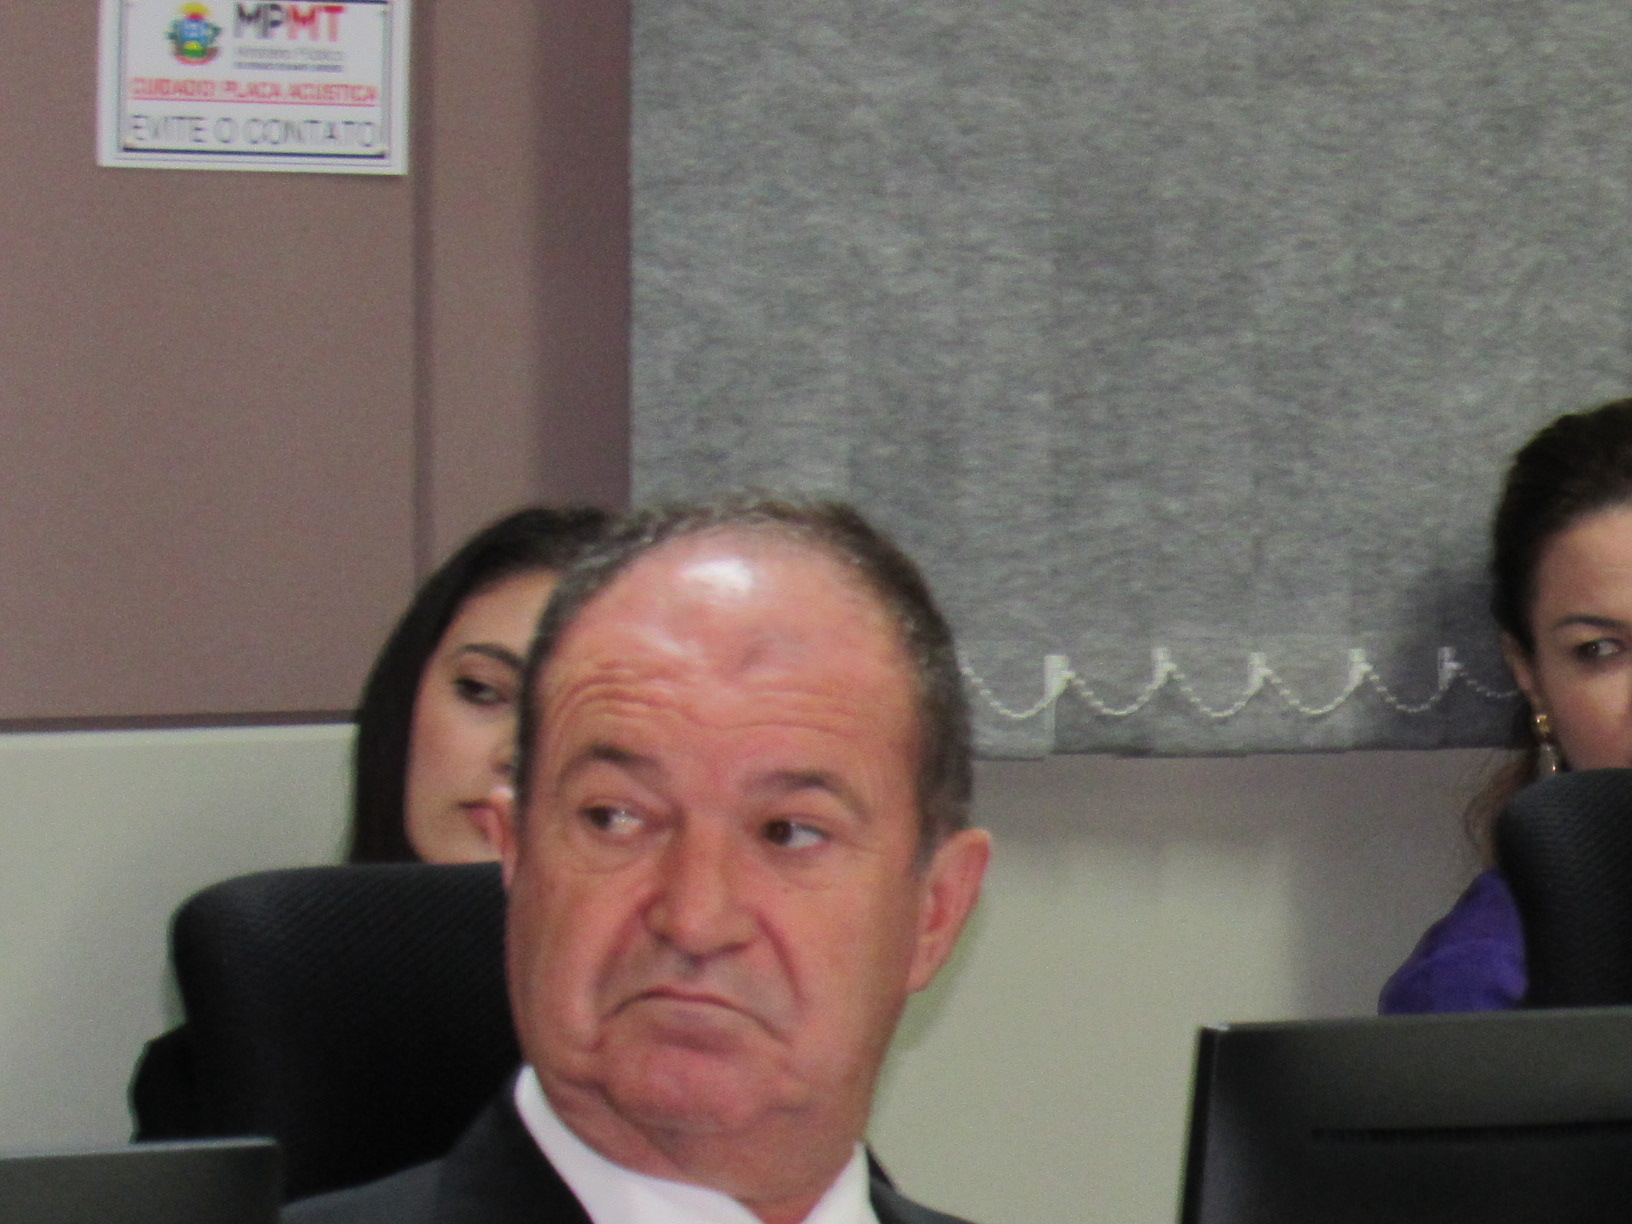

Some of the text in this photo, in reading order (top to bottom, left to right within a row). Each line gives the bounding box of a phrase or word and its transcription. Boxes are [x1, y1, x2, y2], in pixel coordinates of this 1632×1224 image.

[235, 3, 345, 41] MPMT
[222, 80, 282, 99] PLACA
[131, 114, 378, 147] EVITE O CONTATO
